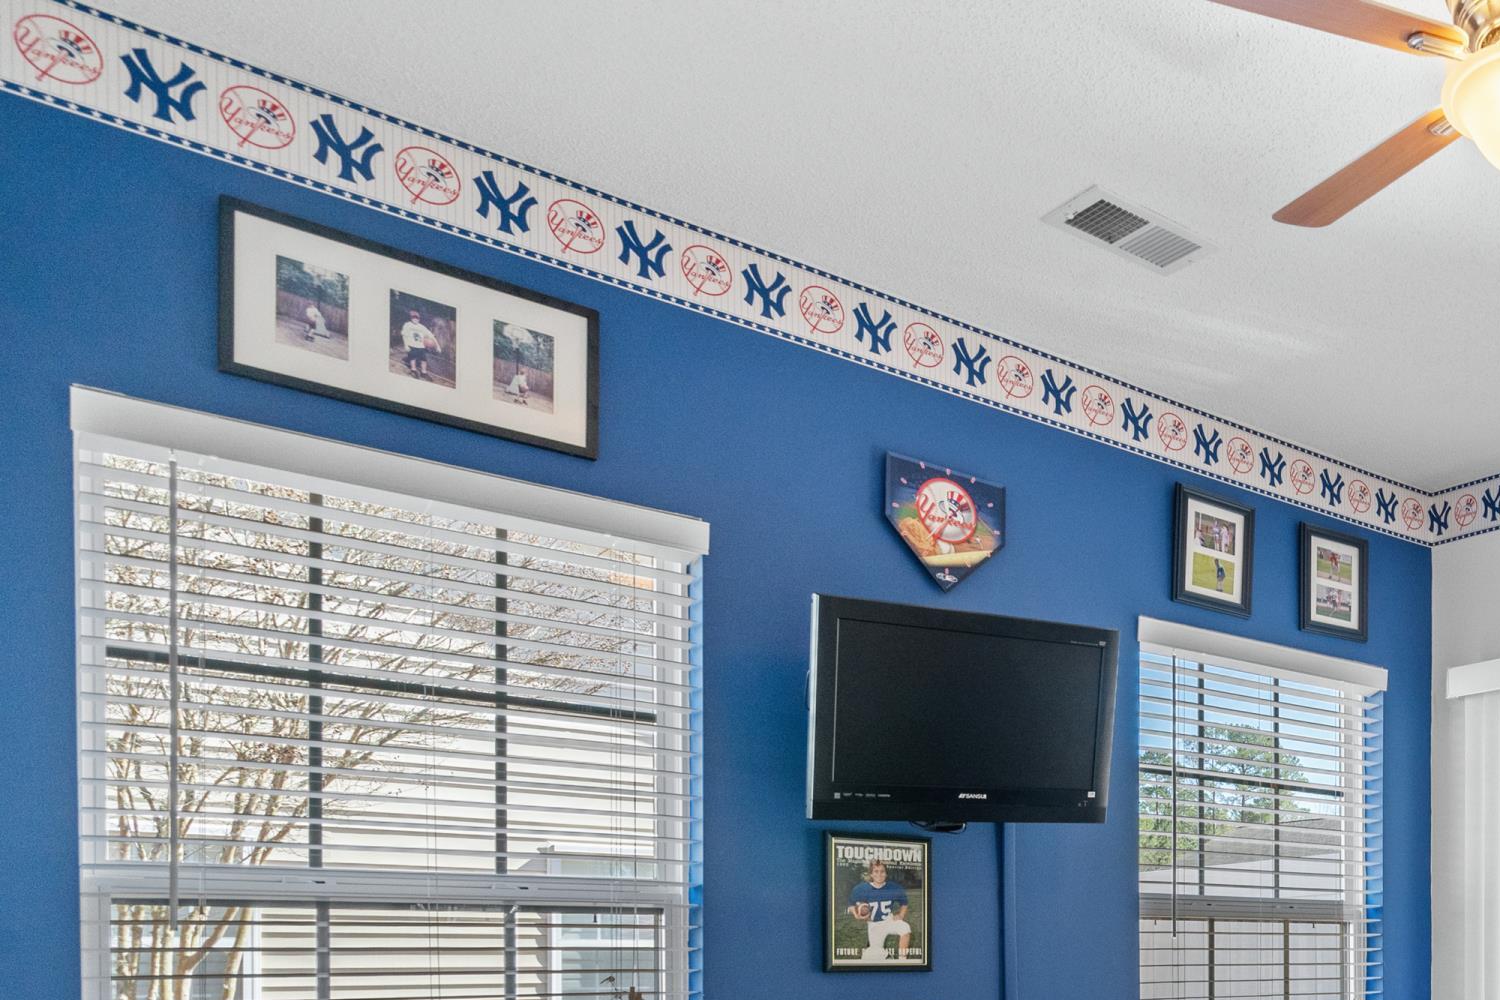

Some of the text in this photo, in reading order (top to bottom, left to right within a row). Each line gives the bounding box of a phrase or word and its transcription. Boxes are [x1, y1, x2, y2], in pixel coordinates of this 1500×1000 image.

[18, 26, 99, 77] Yankees
[223, 97, 294, 143] Yankees
[398, 158, 457, 200] Yankees
[549, 210, 602, 249] Yankees
[682, 256, 731, 292] Yankees
[836, 845, 922, 862] TOUCHDOWN
[869, 900, 892, 921] 75
